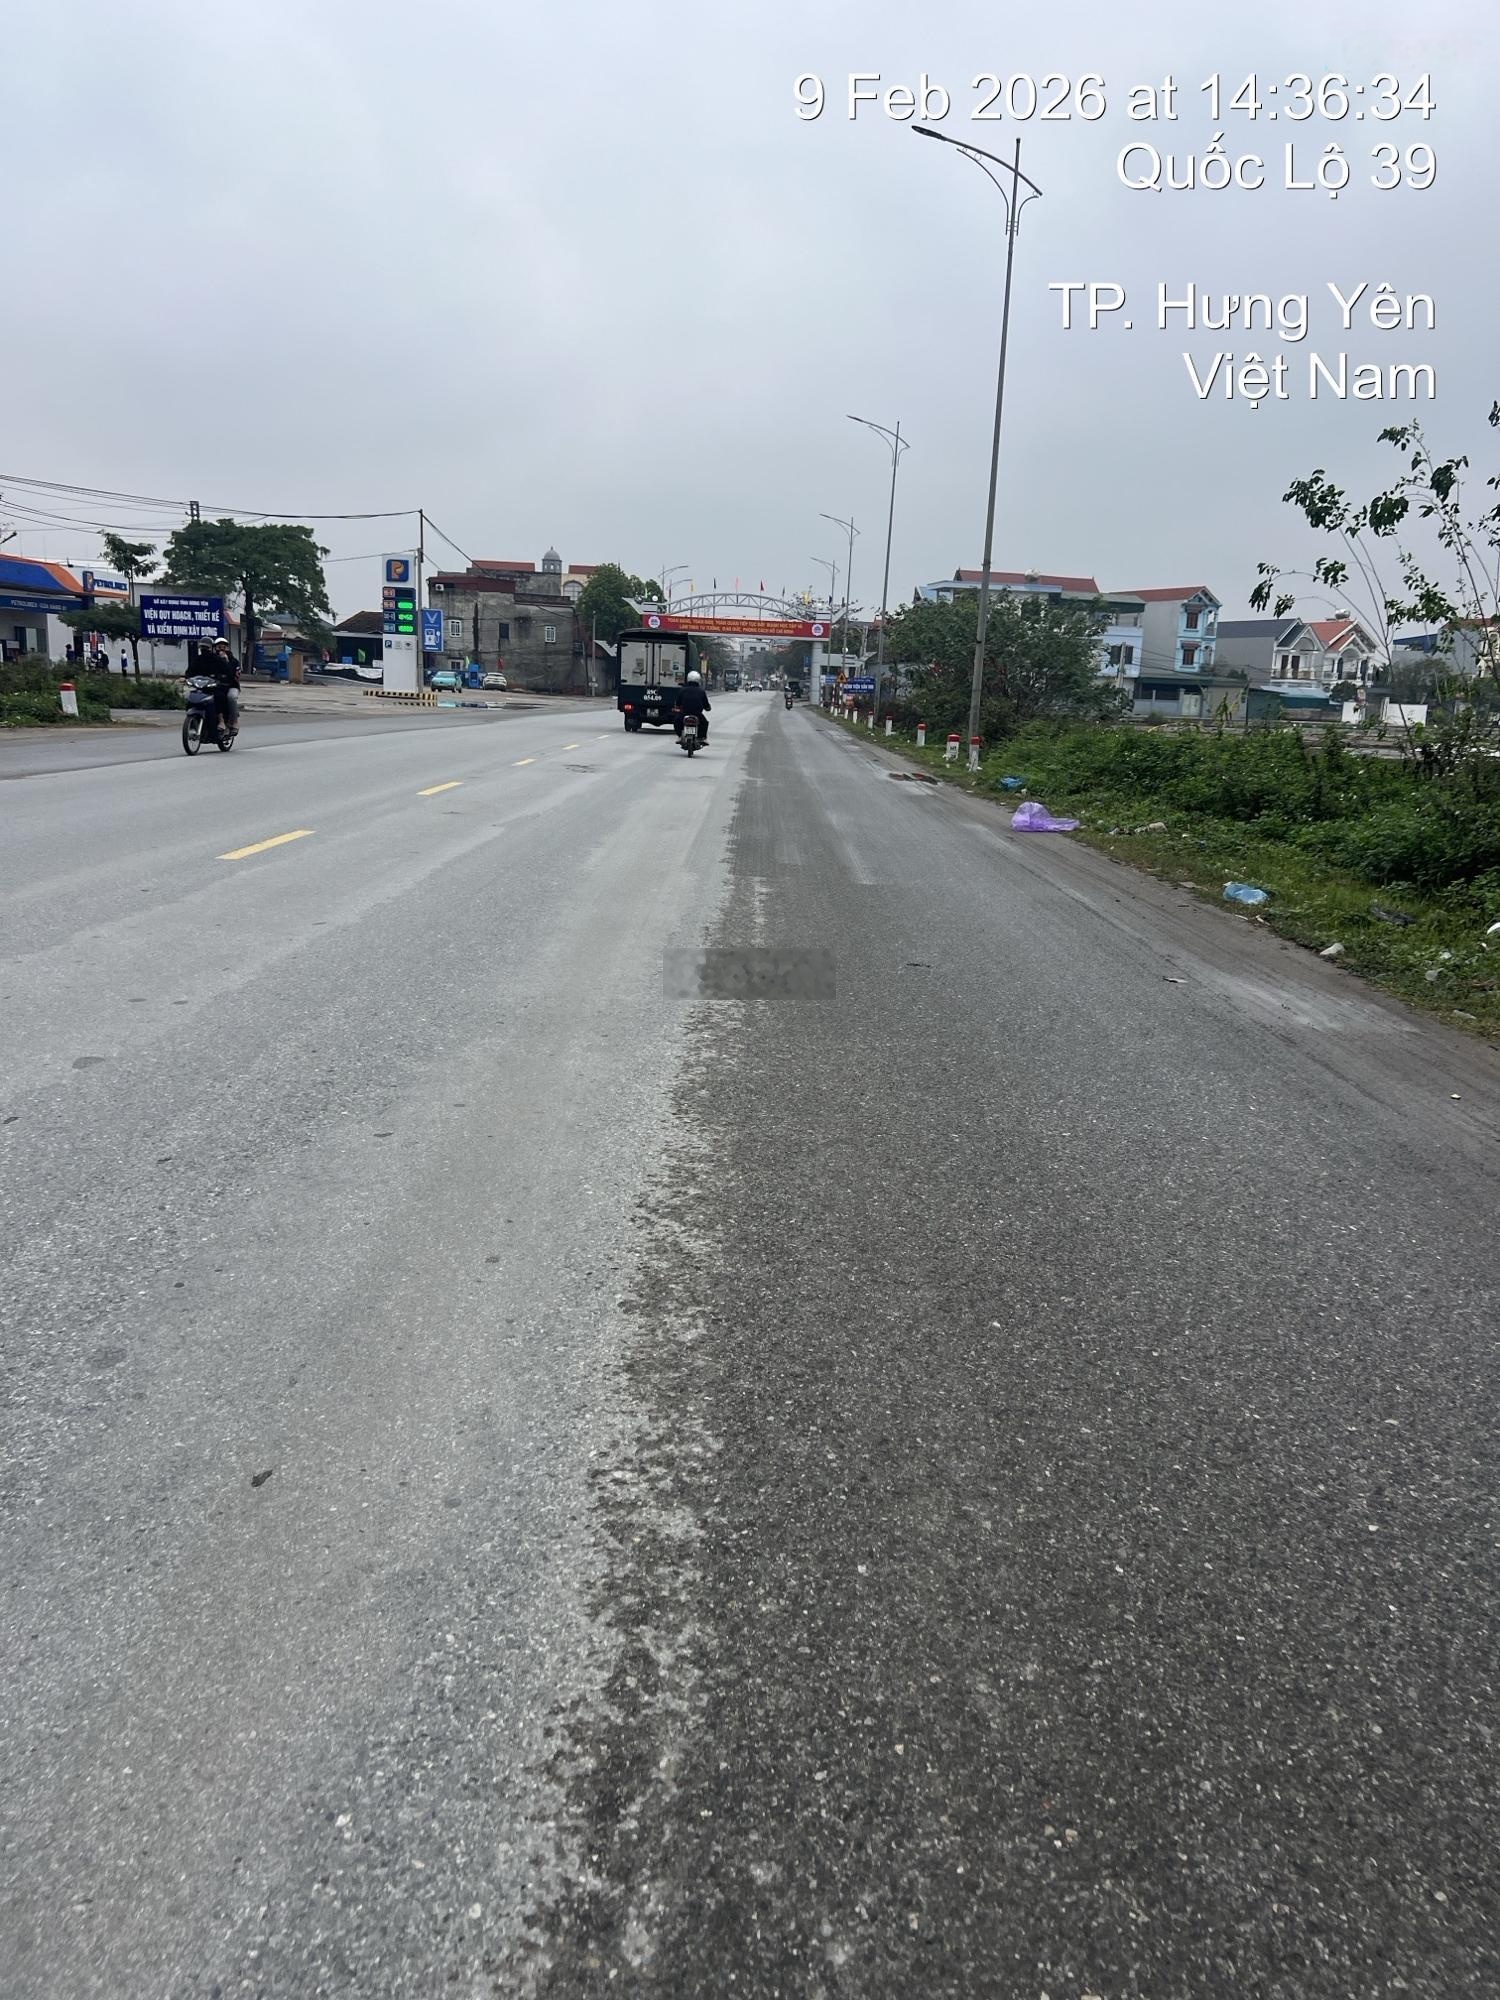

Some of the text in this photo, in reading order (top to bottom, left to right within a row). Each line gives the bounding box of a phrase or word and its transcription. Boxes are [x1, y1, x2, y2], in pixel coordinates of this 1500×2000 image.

[94, 578, 128, 590] PETROLIMEX
[144, 608, 220, 622] VIỆN QUY HOẠCH, THIẾT KẾ
[147, 622, 218, 637] VÀ KIỂM ĐỊNH XÂY DỰNG
